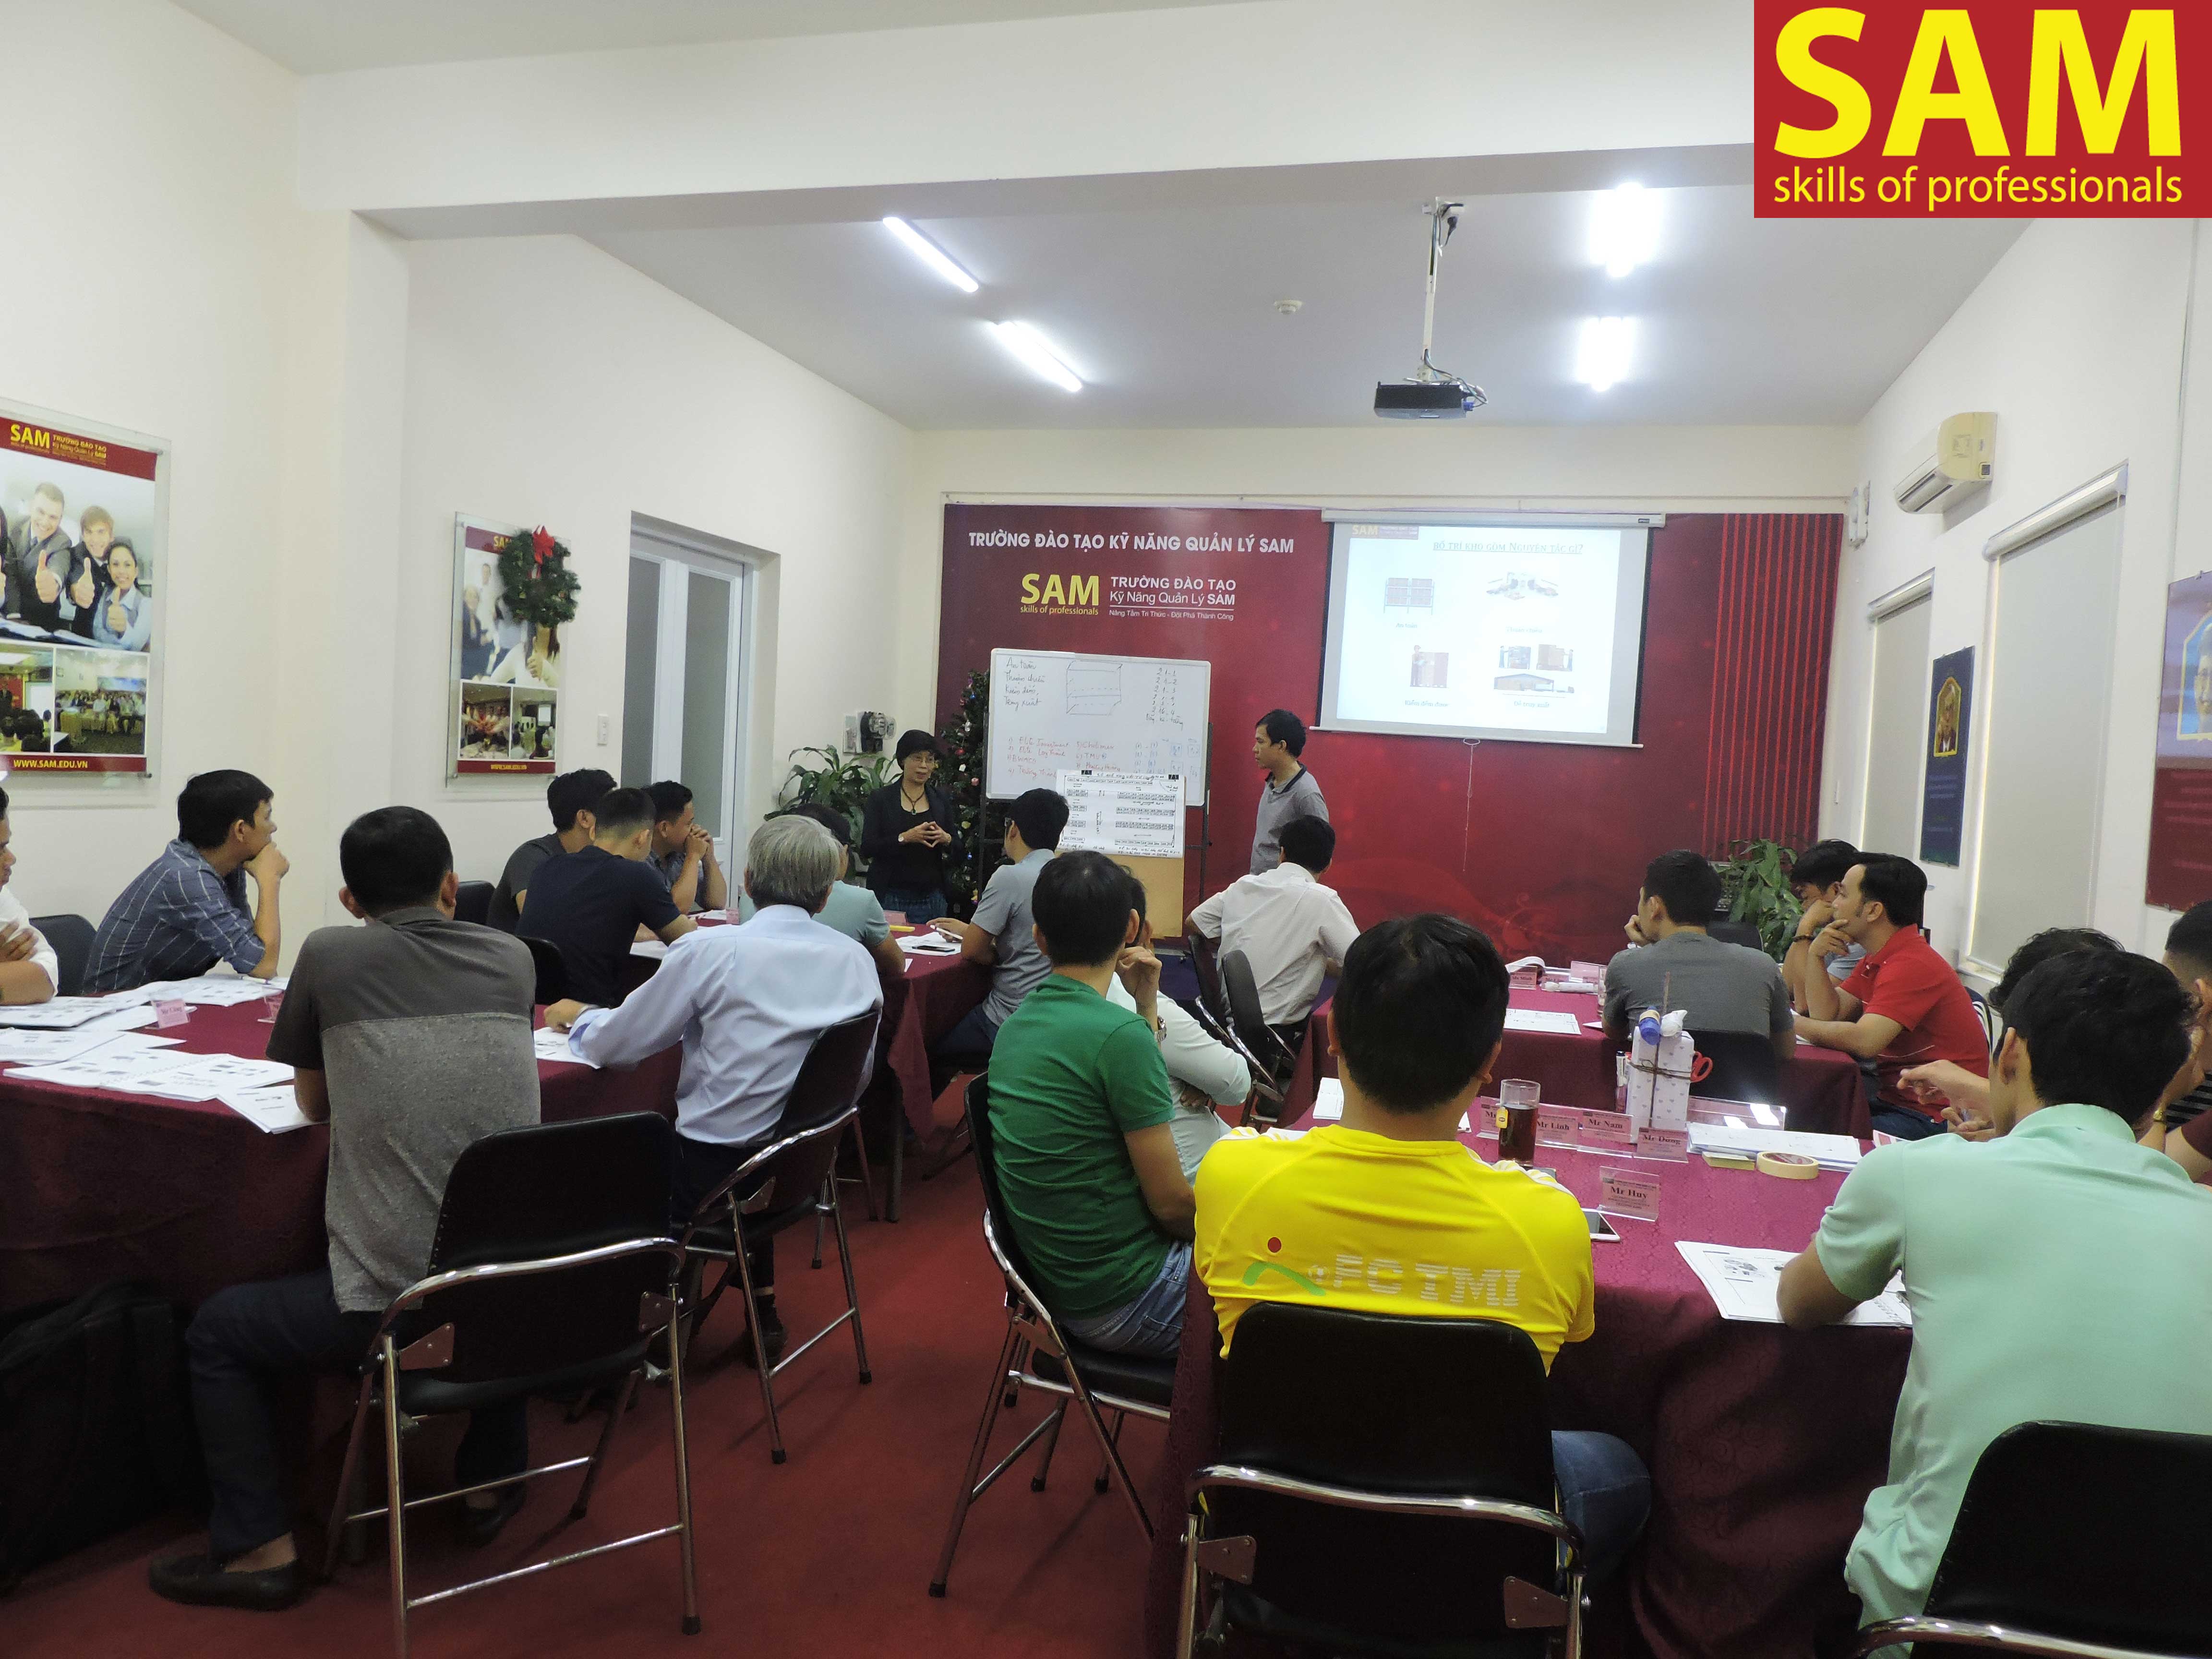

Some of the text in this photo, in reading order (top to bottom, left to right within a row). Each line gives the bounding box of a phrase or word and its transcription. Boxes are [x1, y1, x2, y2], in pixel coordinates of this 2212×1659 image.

[11, 424, 50, 449] SAM
[1352, 525, 1378, 535] SAM
[969, 529, 1294, 553] TRƯỜNG ĐÀO TẠO KỸ NĂNG QUẢN LÝ SAM
[1021, 574, 1099, 606] SAM
[1111, 575, 1236, 592] TRƯỜNG ĐÀO TẠO
[1110, 591, 1235, 606] Kỹ Năng Quản Lý SAM
[1021, 605, 1037, 613] skills
[1049, 606, 1098, 614] professionals
[1604, 1121, 1623, 1129] Nam
[1611, 1186, 1648, 1199] Mr Huy
[1334, 1253, 1521, 1307] FC TMI
